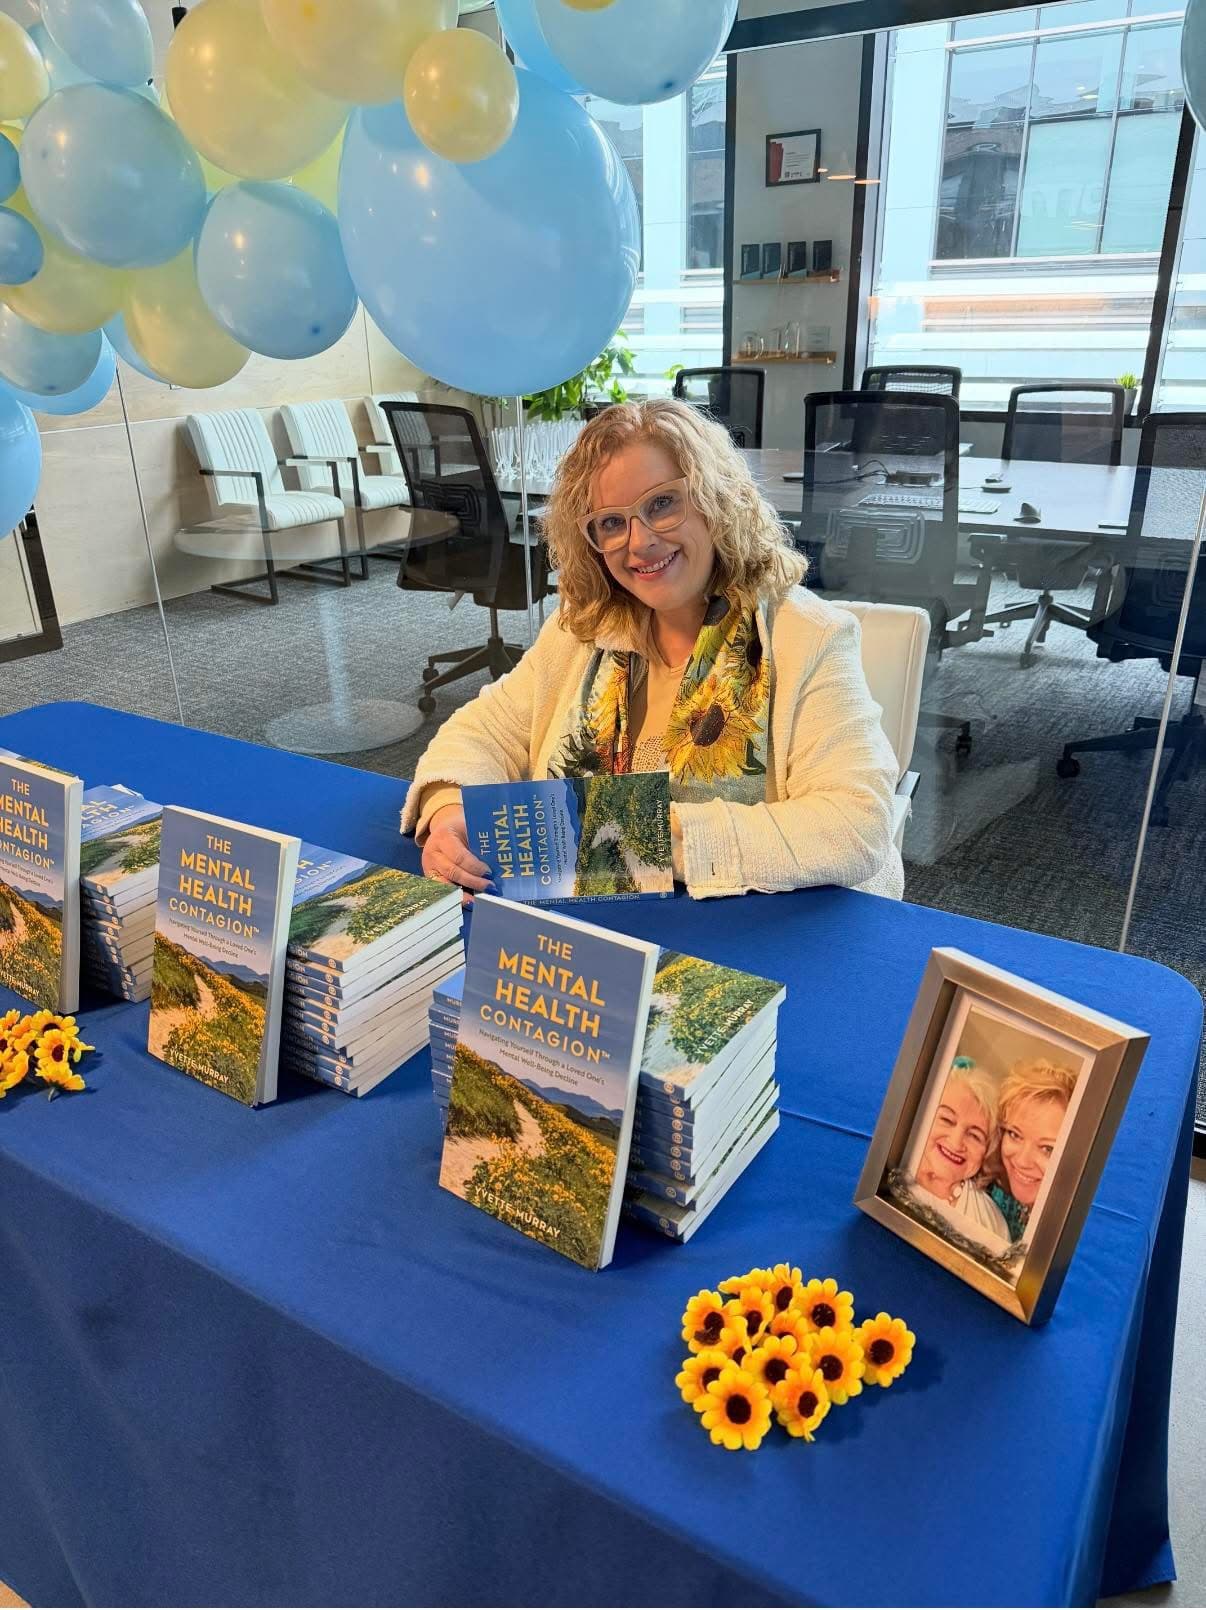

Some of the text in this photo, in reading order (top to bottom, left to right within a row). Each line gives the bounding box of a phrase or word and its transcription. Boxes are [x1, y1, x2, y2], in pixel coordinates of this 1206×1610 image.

[11, 778, 30, 796] THE
[656, 799, 664, 832] MURRAY
[206, 834, 232, 855] THE
[478, 831, 490, 856] THE
[492, 804, 515, 879] MENTAL
[512, 803, 535, 877] HEALTH
[180, 848, 255, 891] MENTAL
[179, 874, 252, 917] HEALTH
[569, 896, 596, 904] HEALTH
[597, 893, 640, 903] CONTAGION
[537, 934, 573, 961] THE
[498, 947, 606, 1007] MENTAL
[495, 978, 600, 1038] HEALTH
[695, 999, 754, 1055] YVETTE MURRAY
[170, 1049, 229, 1084] YVETTE MURRAY
[478, 1028, 509, 1048] Navigating
[510, 1039, 534, 1056] Yourself
[534, 1049, 560, 1069] Through
[566, 1064, 586, 1078] Loved
[586, 1071, 606, 1086] One's
[499, 1048, 579, 1086] Mental Well-Being Decline
[475, 1185, 560, 1238] YVETTE MURRAY
